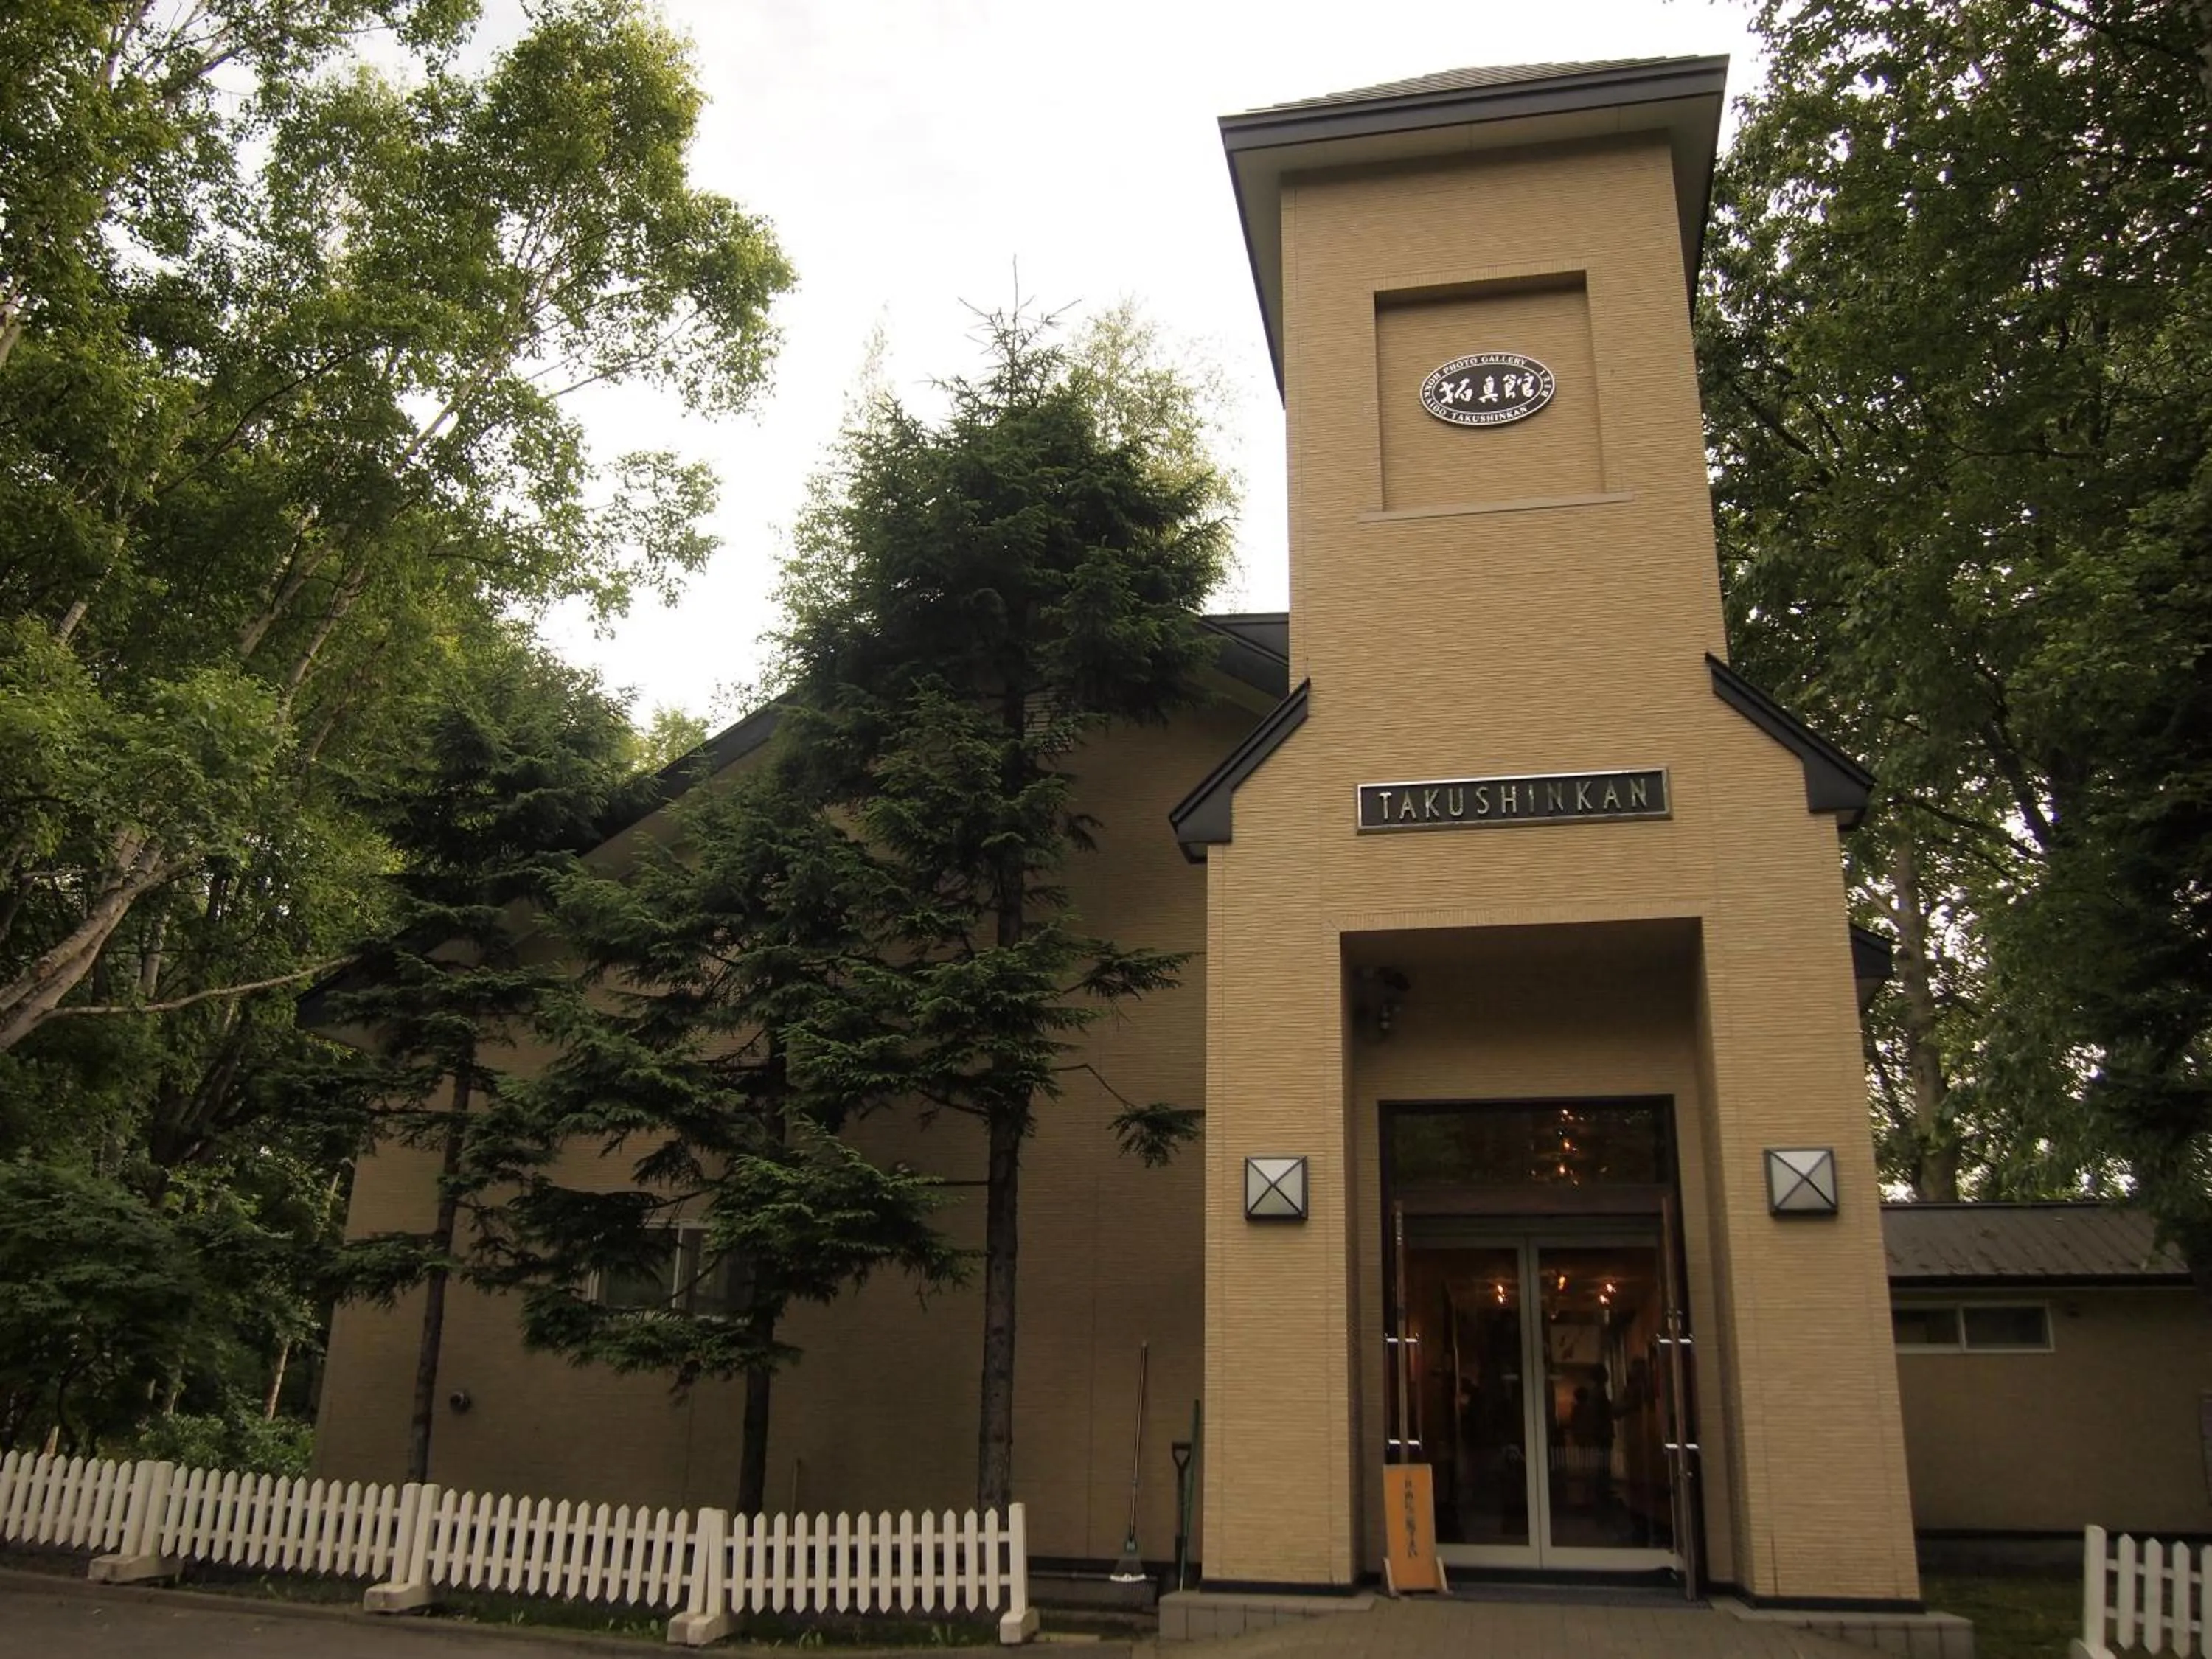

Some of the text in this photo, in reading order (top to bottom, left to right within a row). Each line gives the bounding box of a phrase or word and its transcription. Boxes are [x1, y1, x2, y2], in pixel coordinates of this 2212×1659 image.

[1444, 355, 1528, 375] PHOTO GALLERY
[1450, 405, 1528, 423] TAKUSHINKAN
[1377, 778, 1647, 821] TAKUSHINKAN
